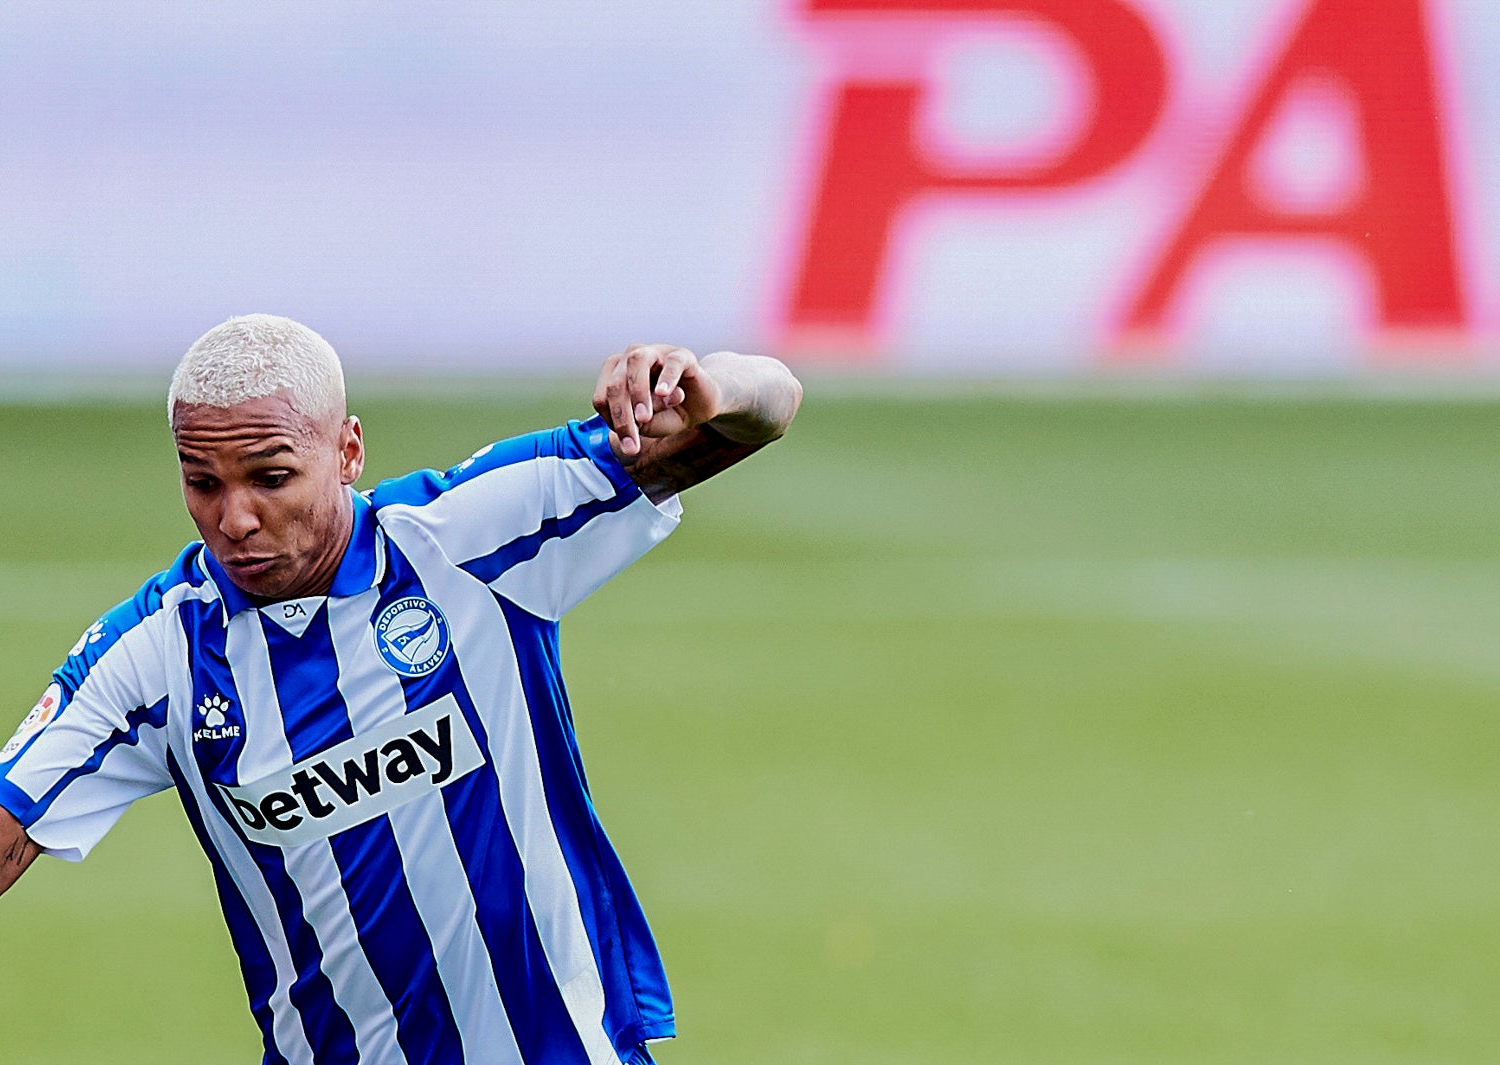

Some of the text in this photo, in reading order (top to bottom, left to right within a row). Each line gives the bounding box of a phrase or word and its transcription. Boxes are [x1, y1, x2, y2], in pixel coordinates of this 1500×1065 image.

[379, 600, 426, 632] DEPORTIVO
[193, 725, 241, 742] KELME
[228, 713, 453, 831] betway
